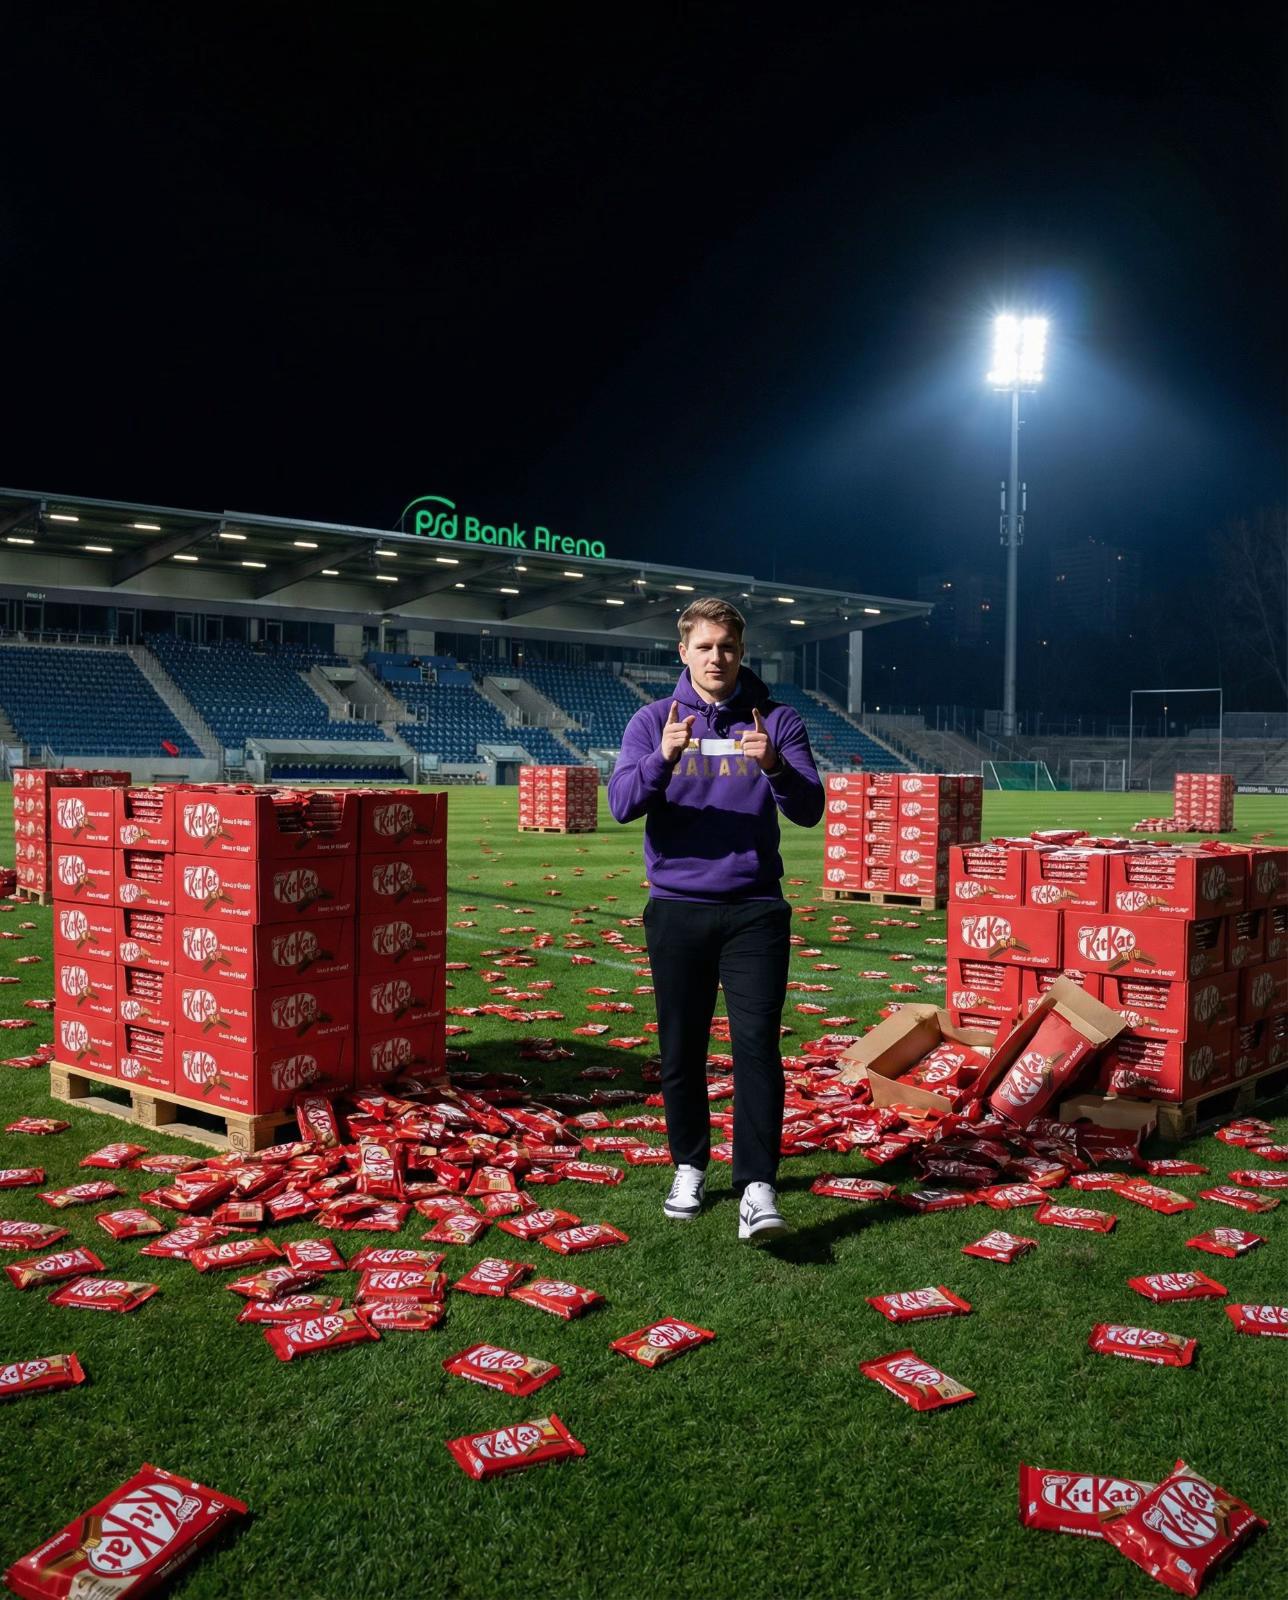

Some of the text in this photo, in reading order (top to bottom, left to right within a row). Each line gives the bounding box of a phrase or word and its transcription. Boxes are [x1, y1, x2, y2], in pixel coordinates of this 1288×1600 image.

[465, 517, 526, 548] Bank
[534, 527, 605, 559] Arena
[968, 917, 1009, 948] KitKat
[1085, 926, 1133, 961] KitKat
[485, 1427, 537, 1457] KitKat
[1054, 1478, 1135, 1512] KitKat
[97, 1488, 180, 1569] KitKat
[1158, 1483, 1216, 1547] KitKat
